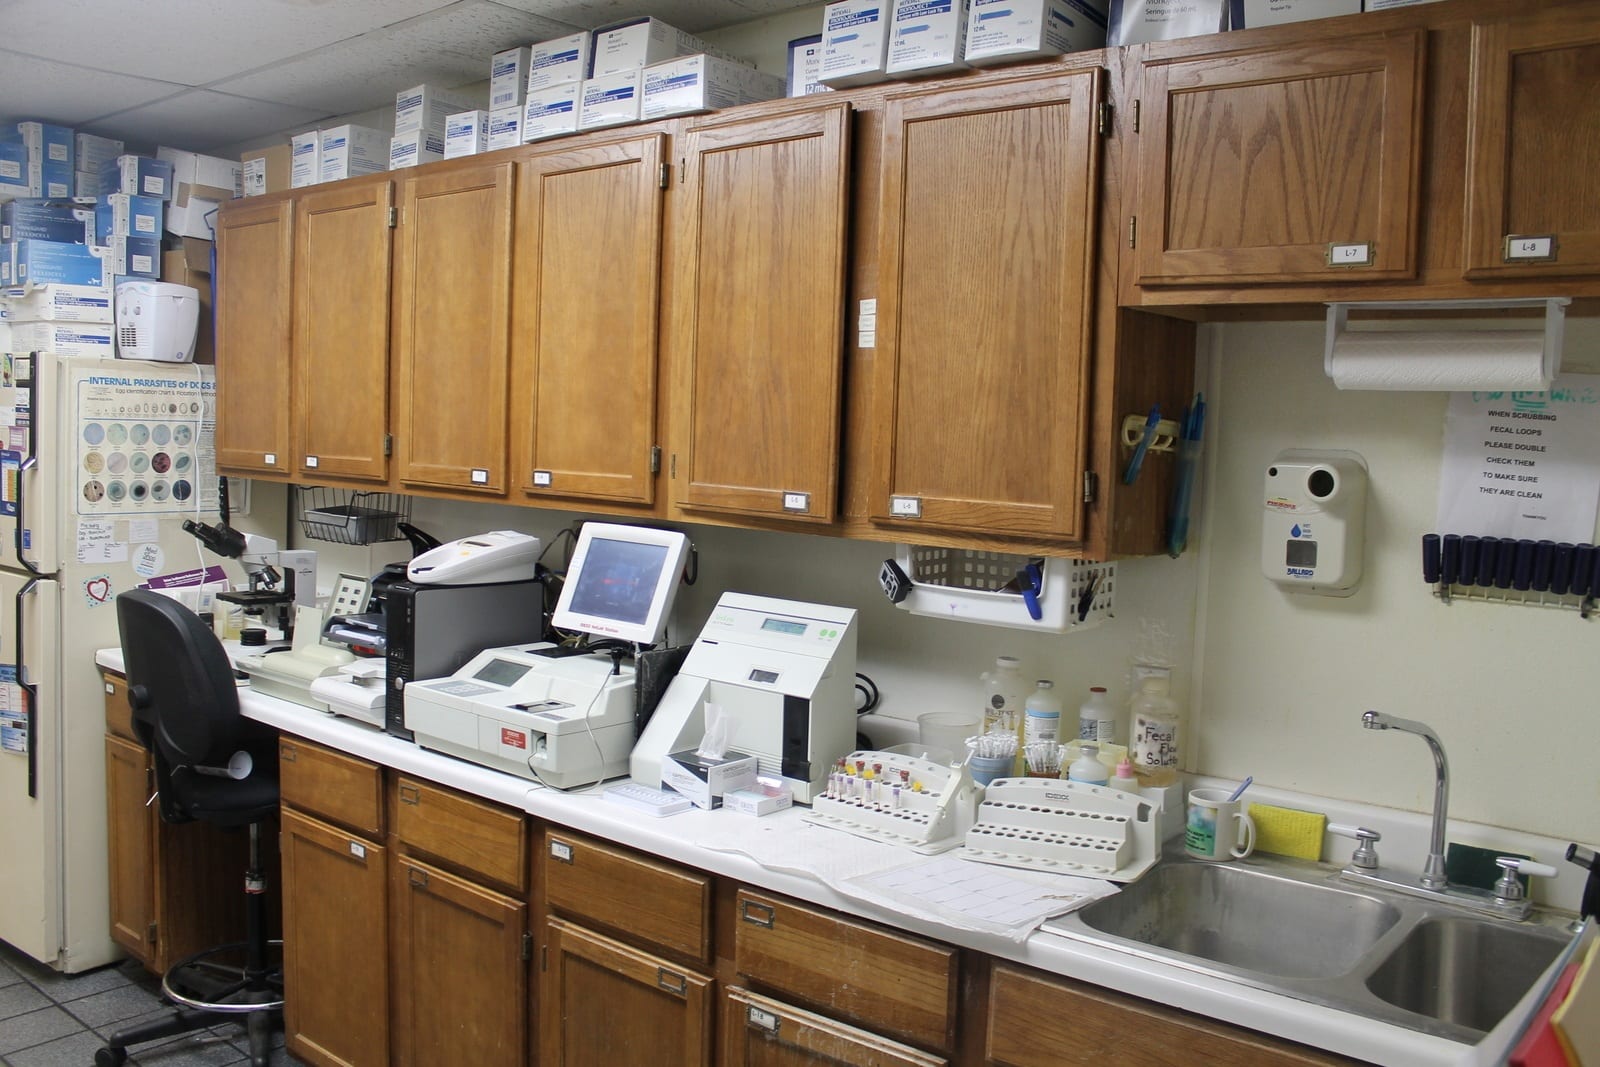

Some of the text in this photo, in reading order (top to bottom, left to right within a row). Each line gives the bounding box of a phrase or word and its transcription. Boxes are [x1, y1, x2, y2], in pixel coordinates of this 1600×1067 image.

[1522, 243, 1536, 251] L-8
[1345, 249, 1357, 257] L-7
[89, 376, 132, 387] INTERNAL
[133, 378, 177, 388] PARASITES
[1488, 410, 1557, 421] WHEN SCRUBBING
[1489, 425, 1542, 436] FECAL LOOPS
[1484, 441, 1547, 452] PLEASE DOUBLE
[1486, 456, 1536, 467] CHECK THEM
[1483, 471, 1538, 483] TO MAKE SURE
[1479, 486, 1543, 499] THEY ARE CLEAN
[1287, 567, 1314, 576] BALLARD
[1145, 726, 1175, 741] Fecal
[1045, 792, 1070, 800] IDEXX
